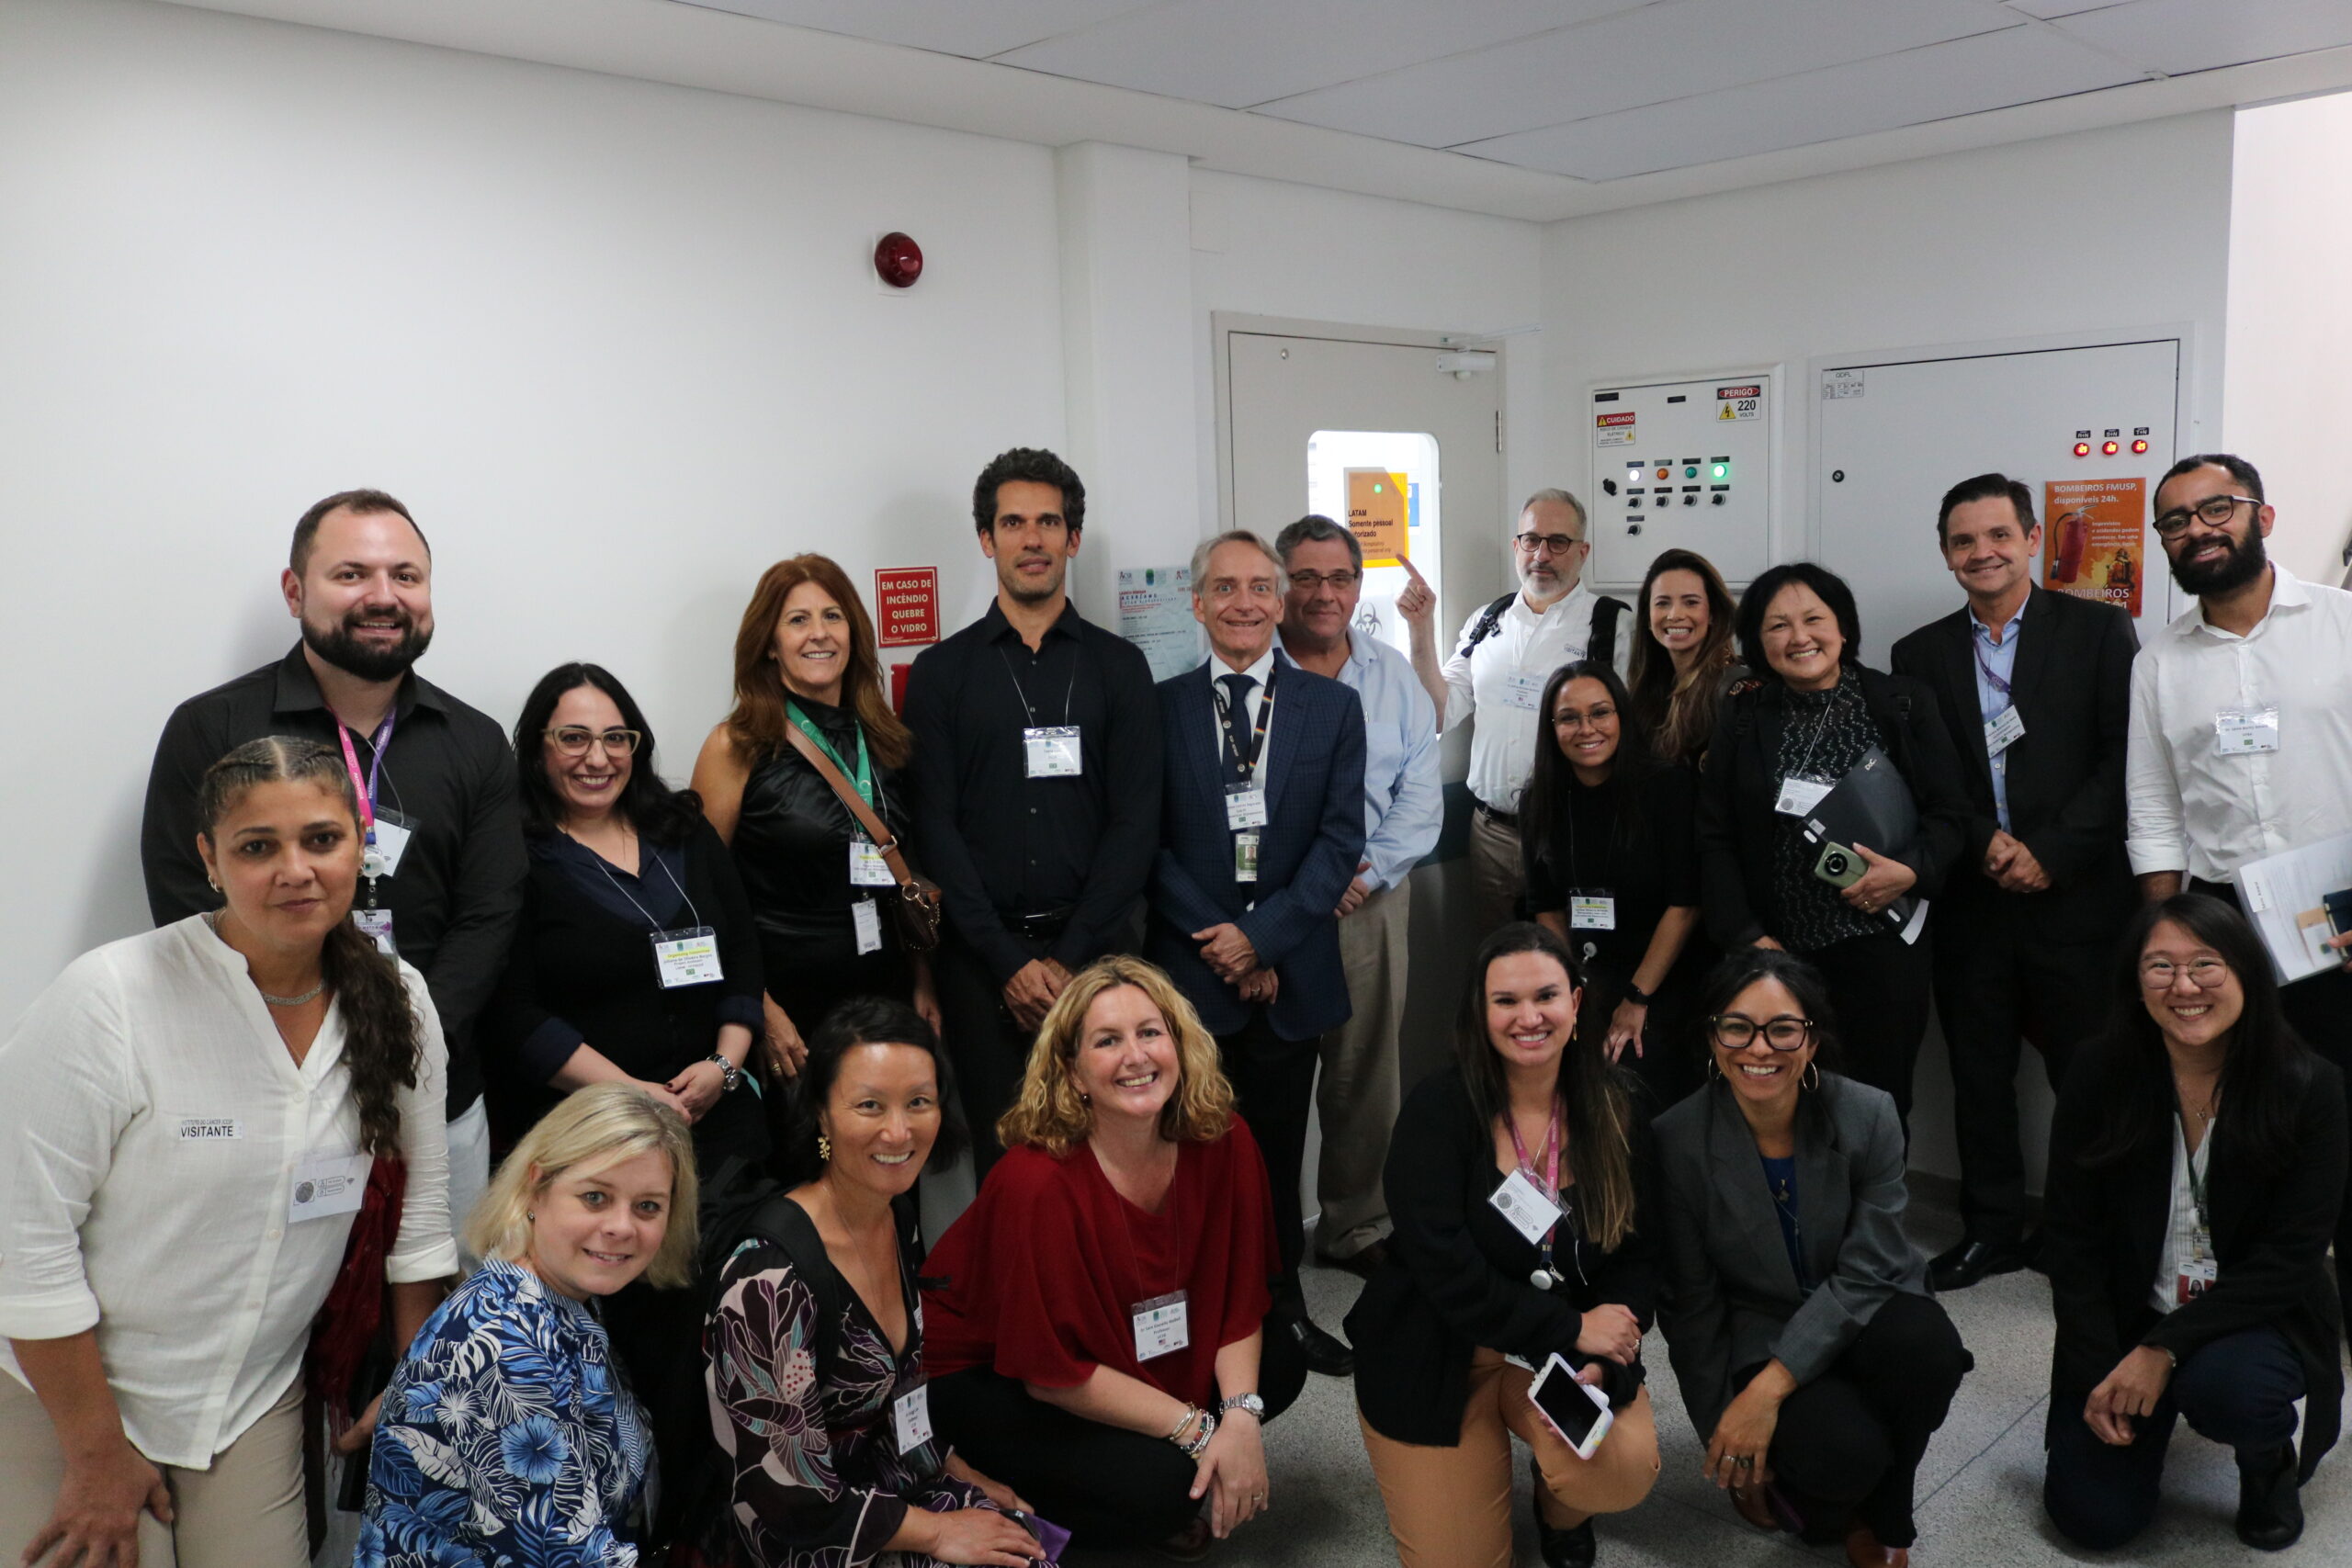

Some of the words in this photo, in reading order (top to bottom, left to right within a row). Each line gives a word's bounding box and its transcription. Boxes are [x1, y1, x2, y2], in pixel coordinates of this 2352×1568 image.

[1724, 389, 1752, 397] PERIGO
[1738, 400, 1756, 411] 220
[2054, 484, 2104, 492] BOMBEIROS
[2107, 482, 2137, 491] FMUSP,
[2054, 496, 2099, 505] disponíveis
[1373, 519, 1393, 527] pessoal
[882, 581, 894, 590] EM
[897, 580, 919, 590] CASO
[921, 579, 932, 588] DE
[887, 592, 929, 604] INCÊNDIO
[891, 609, 924, 619] QUEBRE
[891, 625, 898, 634] O
[900, 623, 927, 633] VIDRO
[354, 772, 364, 800] PATOLOGIA
[181, 1125, 233, 1137] VISITANTE
